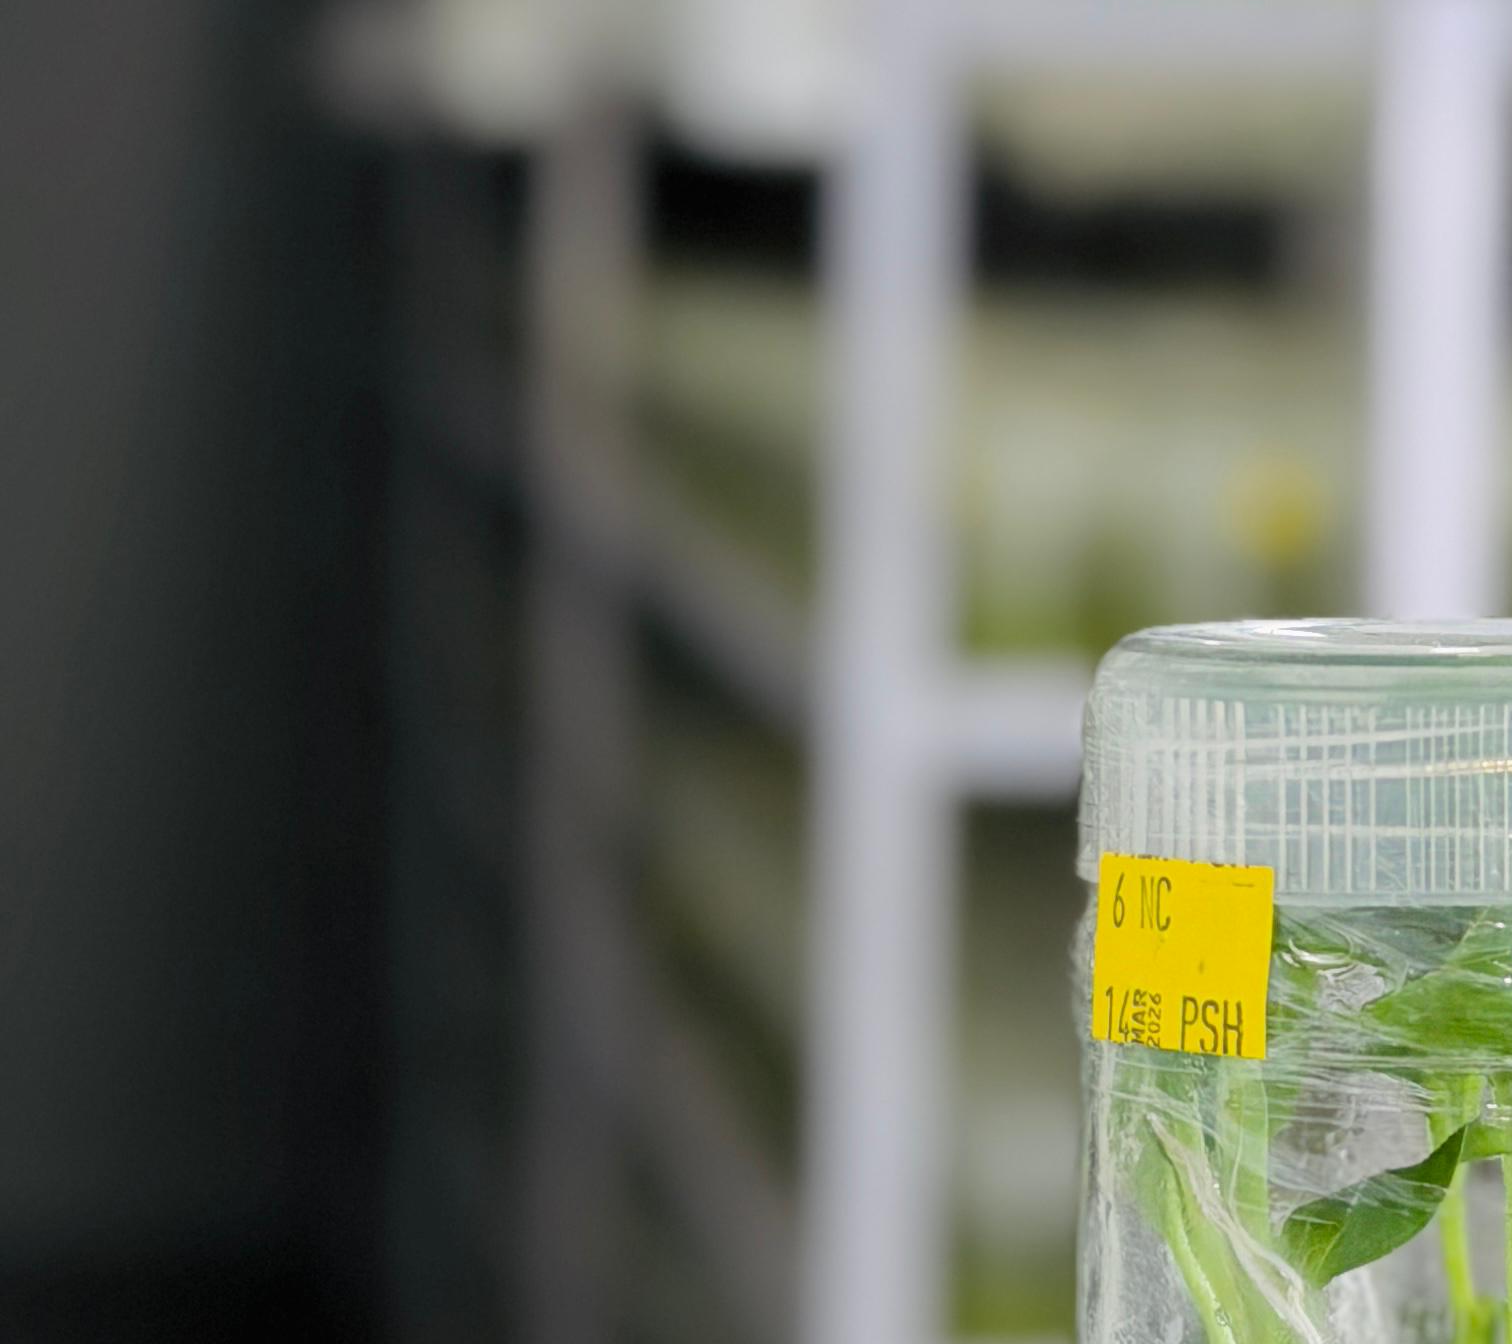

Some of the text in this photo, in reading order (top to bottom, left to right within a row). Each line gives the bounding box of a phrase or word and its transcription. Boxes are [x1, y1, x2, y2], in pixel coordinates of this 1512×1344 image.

[1113, 872, 1172, 932] 6 NC
[1105, 985, 1243, 1056] 14 PSH
[1131, 988, 1147, 1045] MAR
[1147, 992, 1162, 1048] 2026
